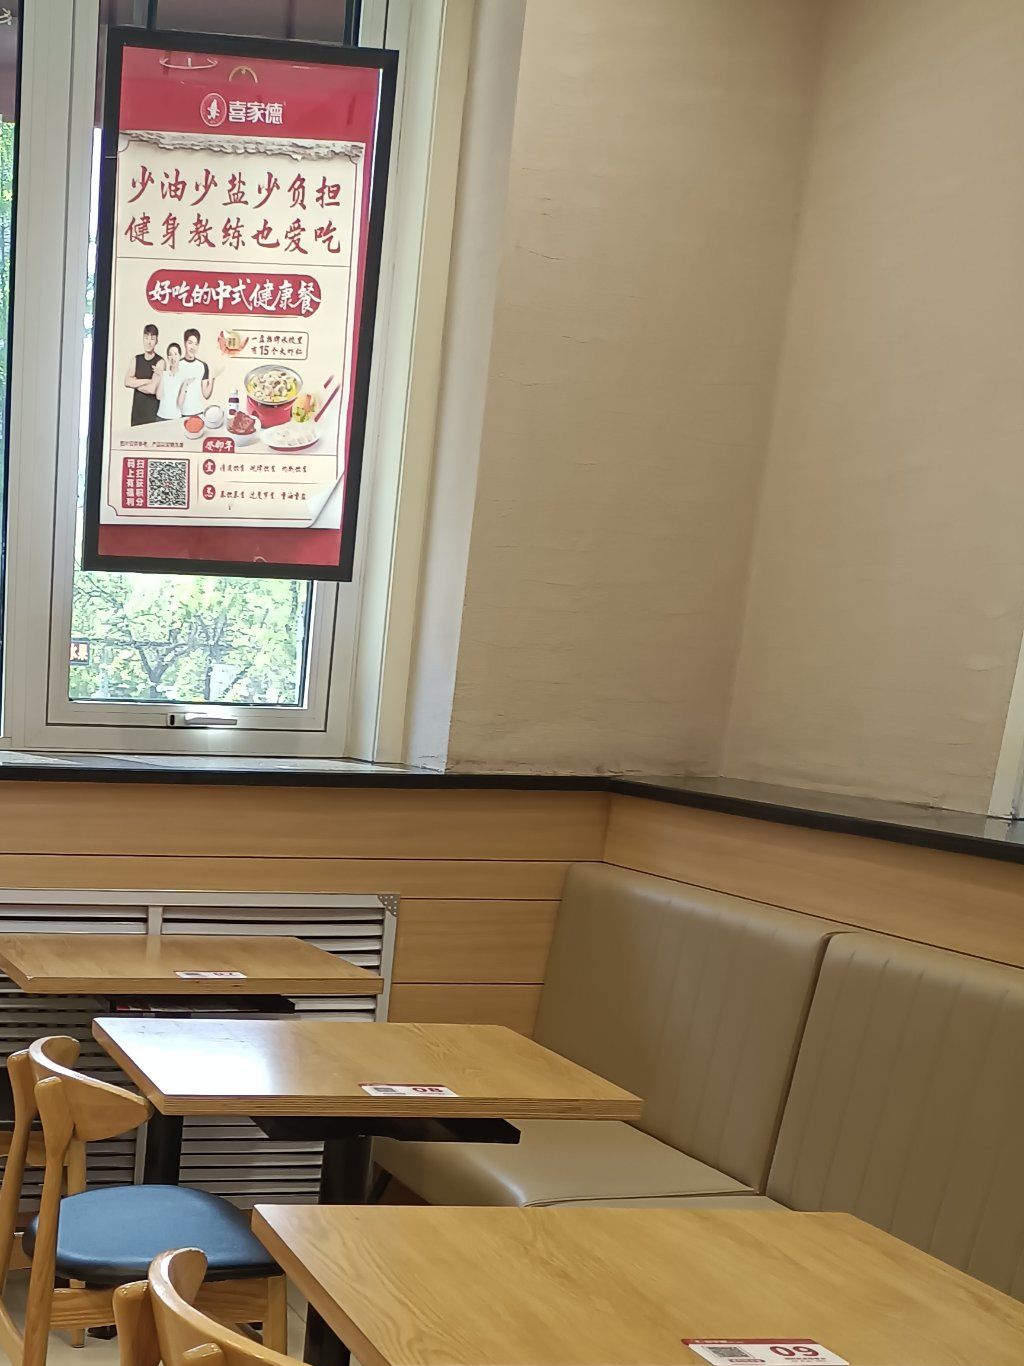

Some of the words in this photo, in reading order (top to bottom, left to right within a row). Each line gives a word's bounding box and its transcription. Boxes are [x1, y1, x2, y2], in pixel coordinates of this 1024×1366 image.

[228, 100, 283, 124] 喜家德
[127, 165, 341, 210] 少油少盐少负担
[124, 211, 342, 255] 健身教练也爱吃
[147, 277, 322, 315] 好吃的中式健康餐
[769, 1345, 819, 1357] 09
